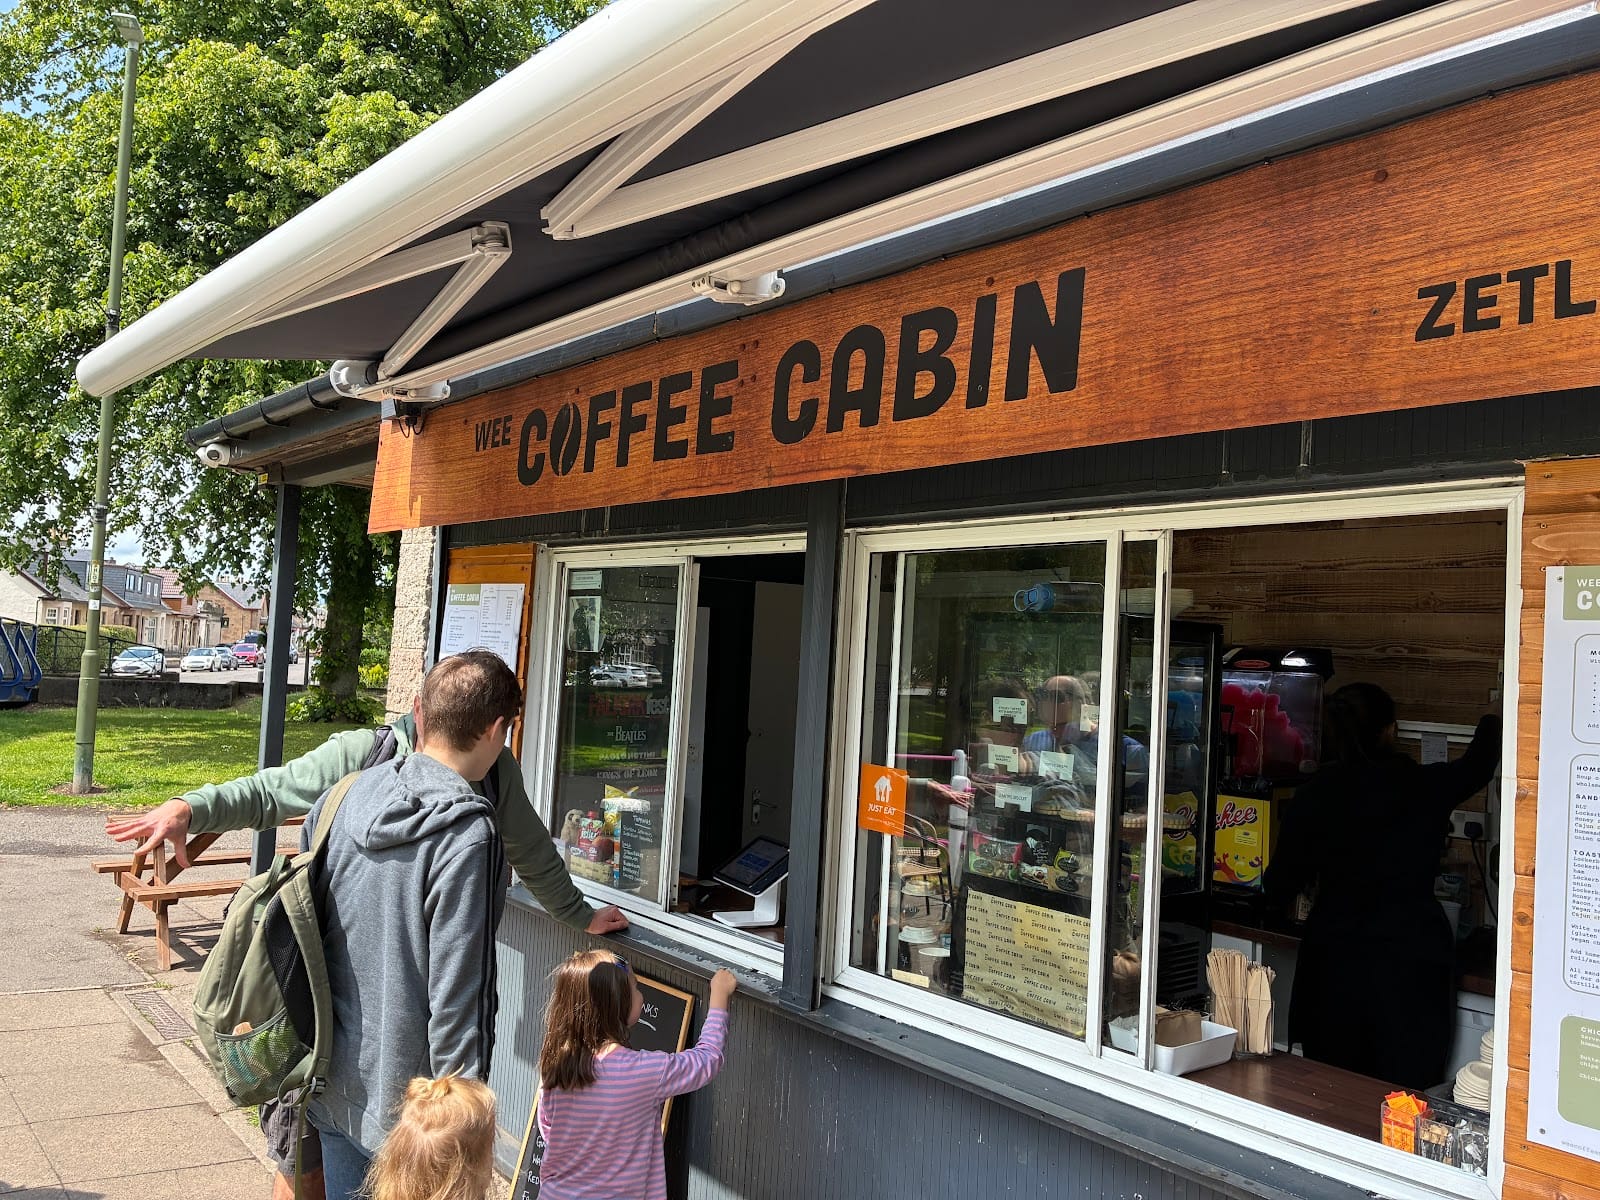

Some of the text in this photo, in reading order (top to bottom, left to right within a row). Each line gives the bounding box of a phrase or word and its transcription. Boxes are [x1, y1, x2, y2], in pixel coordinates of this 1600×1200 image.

[1415, 260, 1597, 342] ZETL
[474, 266, 1087, 487] WEE COFFEE CABIN
[615, 725, 647, 743] BEATLES
[867, 803, 896, 816] JUST EAT
[641, 1002, 659, 1018] NKS
